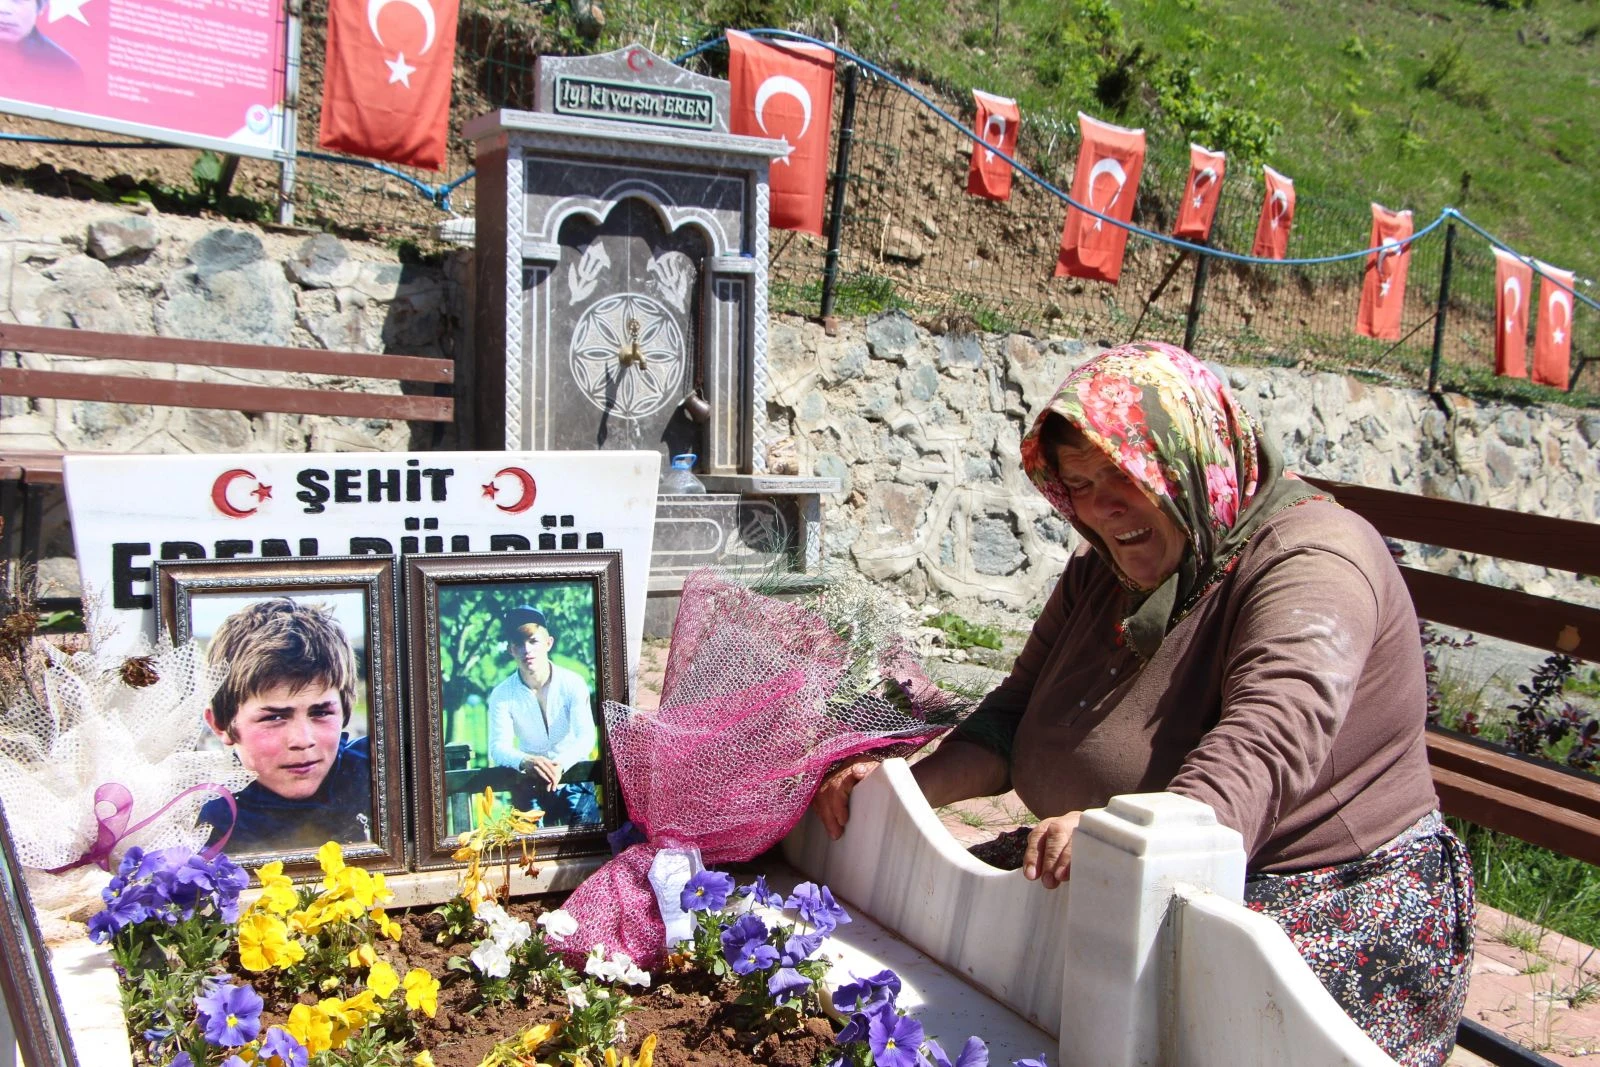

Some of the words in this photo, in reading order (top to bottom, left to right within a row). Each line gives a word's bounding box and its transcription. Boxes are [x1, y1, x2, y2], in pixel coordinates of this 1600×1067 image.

[591, 84, 607, 105] ki
[664, 95, 710, 116] EREN
[296, 459, 454, 514] ŞEHİT
